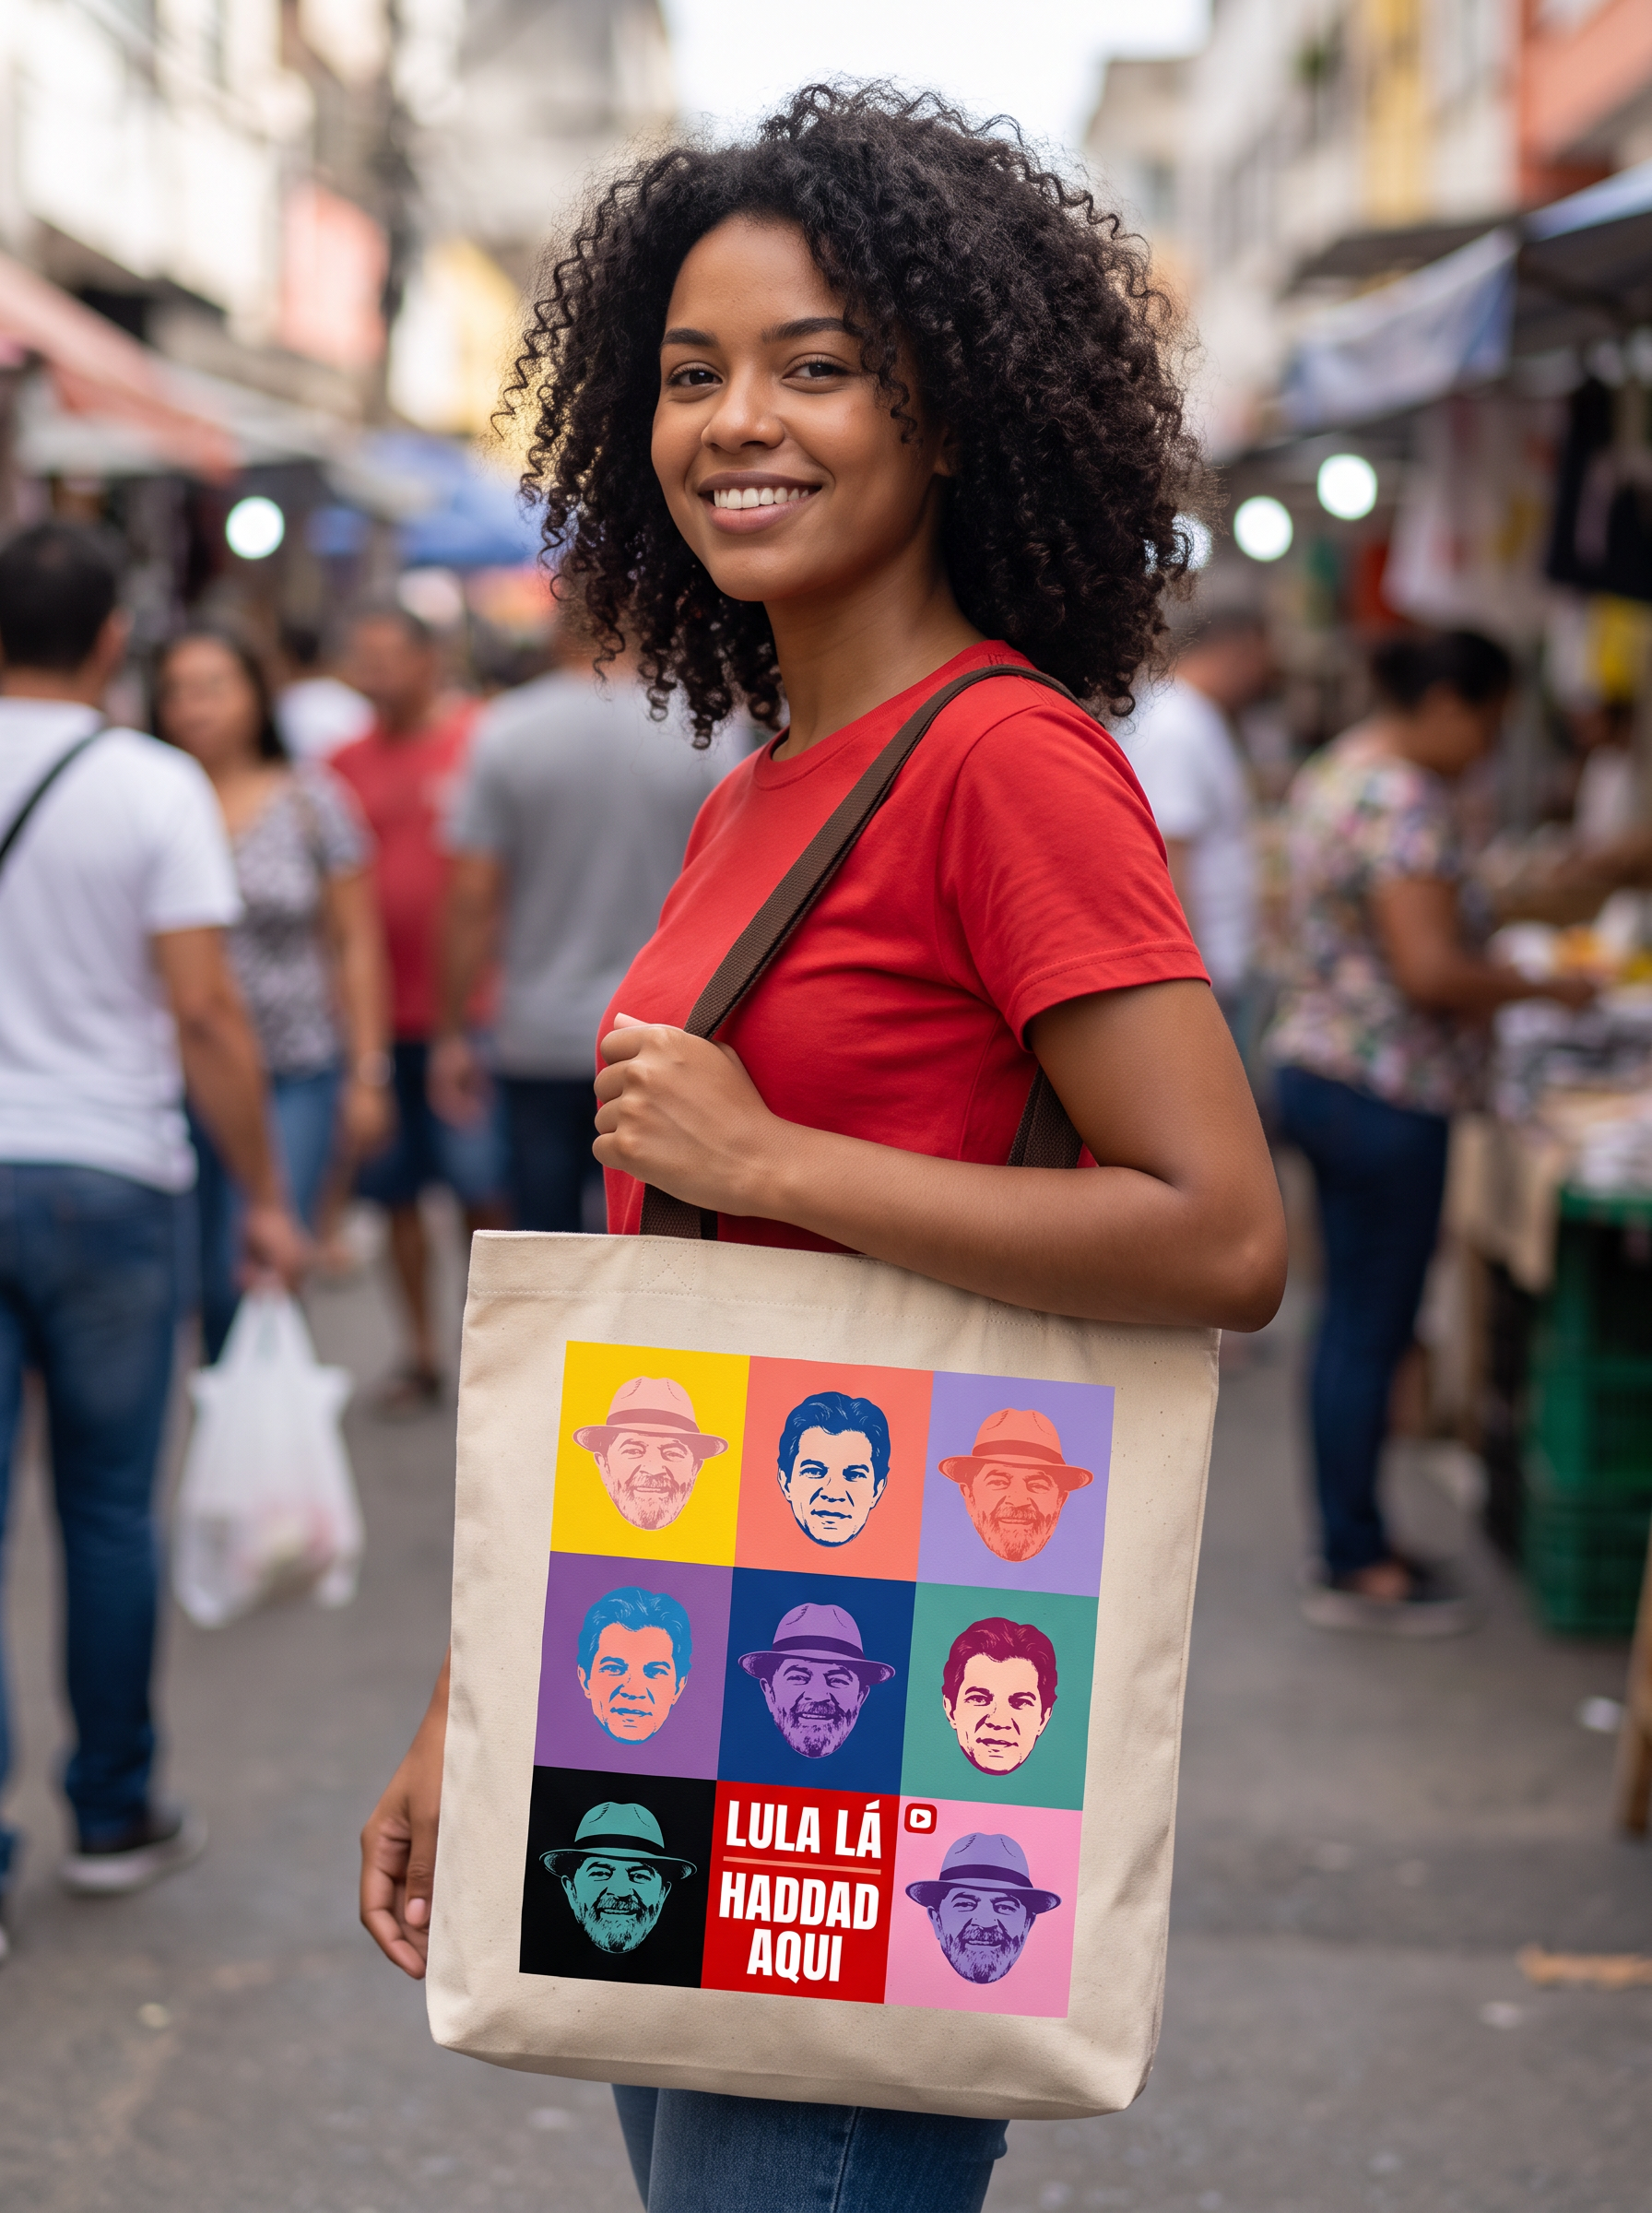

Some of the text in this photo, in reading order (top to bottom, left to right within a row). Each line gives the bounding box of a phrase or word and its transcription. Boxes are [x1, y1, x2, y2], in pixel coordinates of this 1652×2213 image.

[726, 1799, 882, 1859] LULA LÁ
[719, 1871, 879, 1931] HADDAD
[746, 1928, 843, 1984] AQUI
